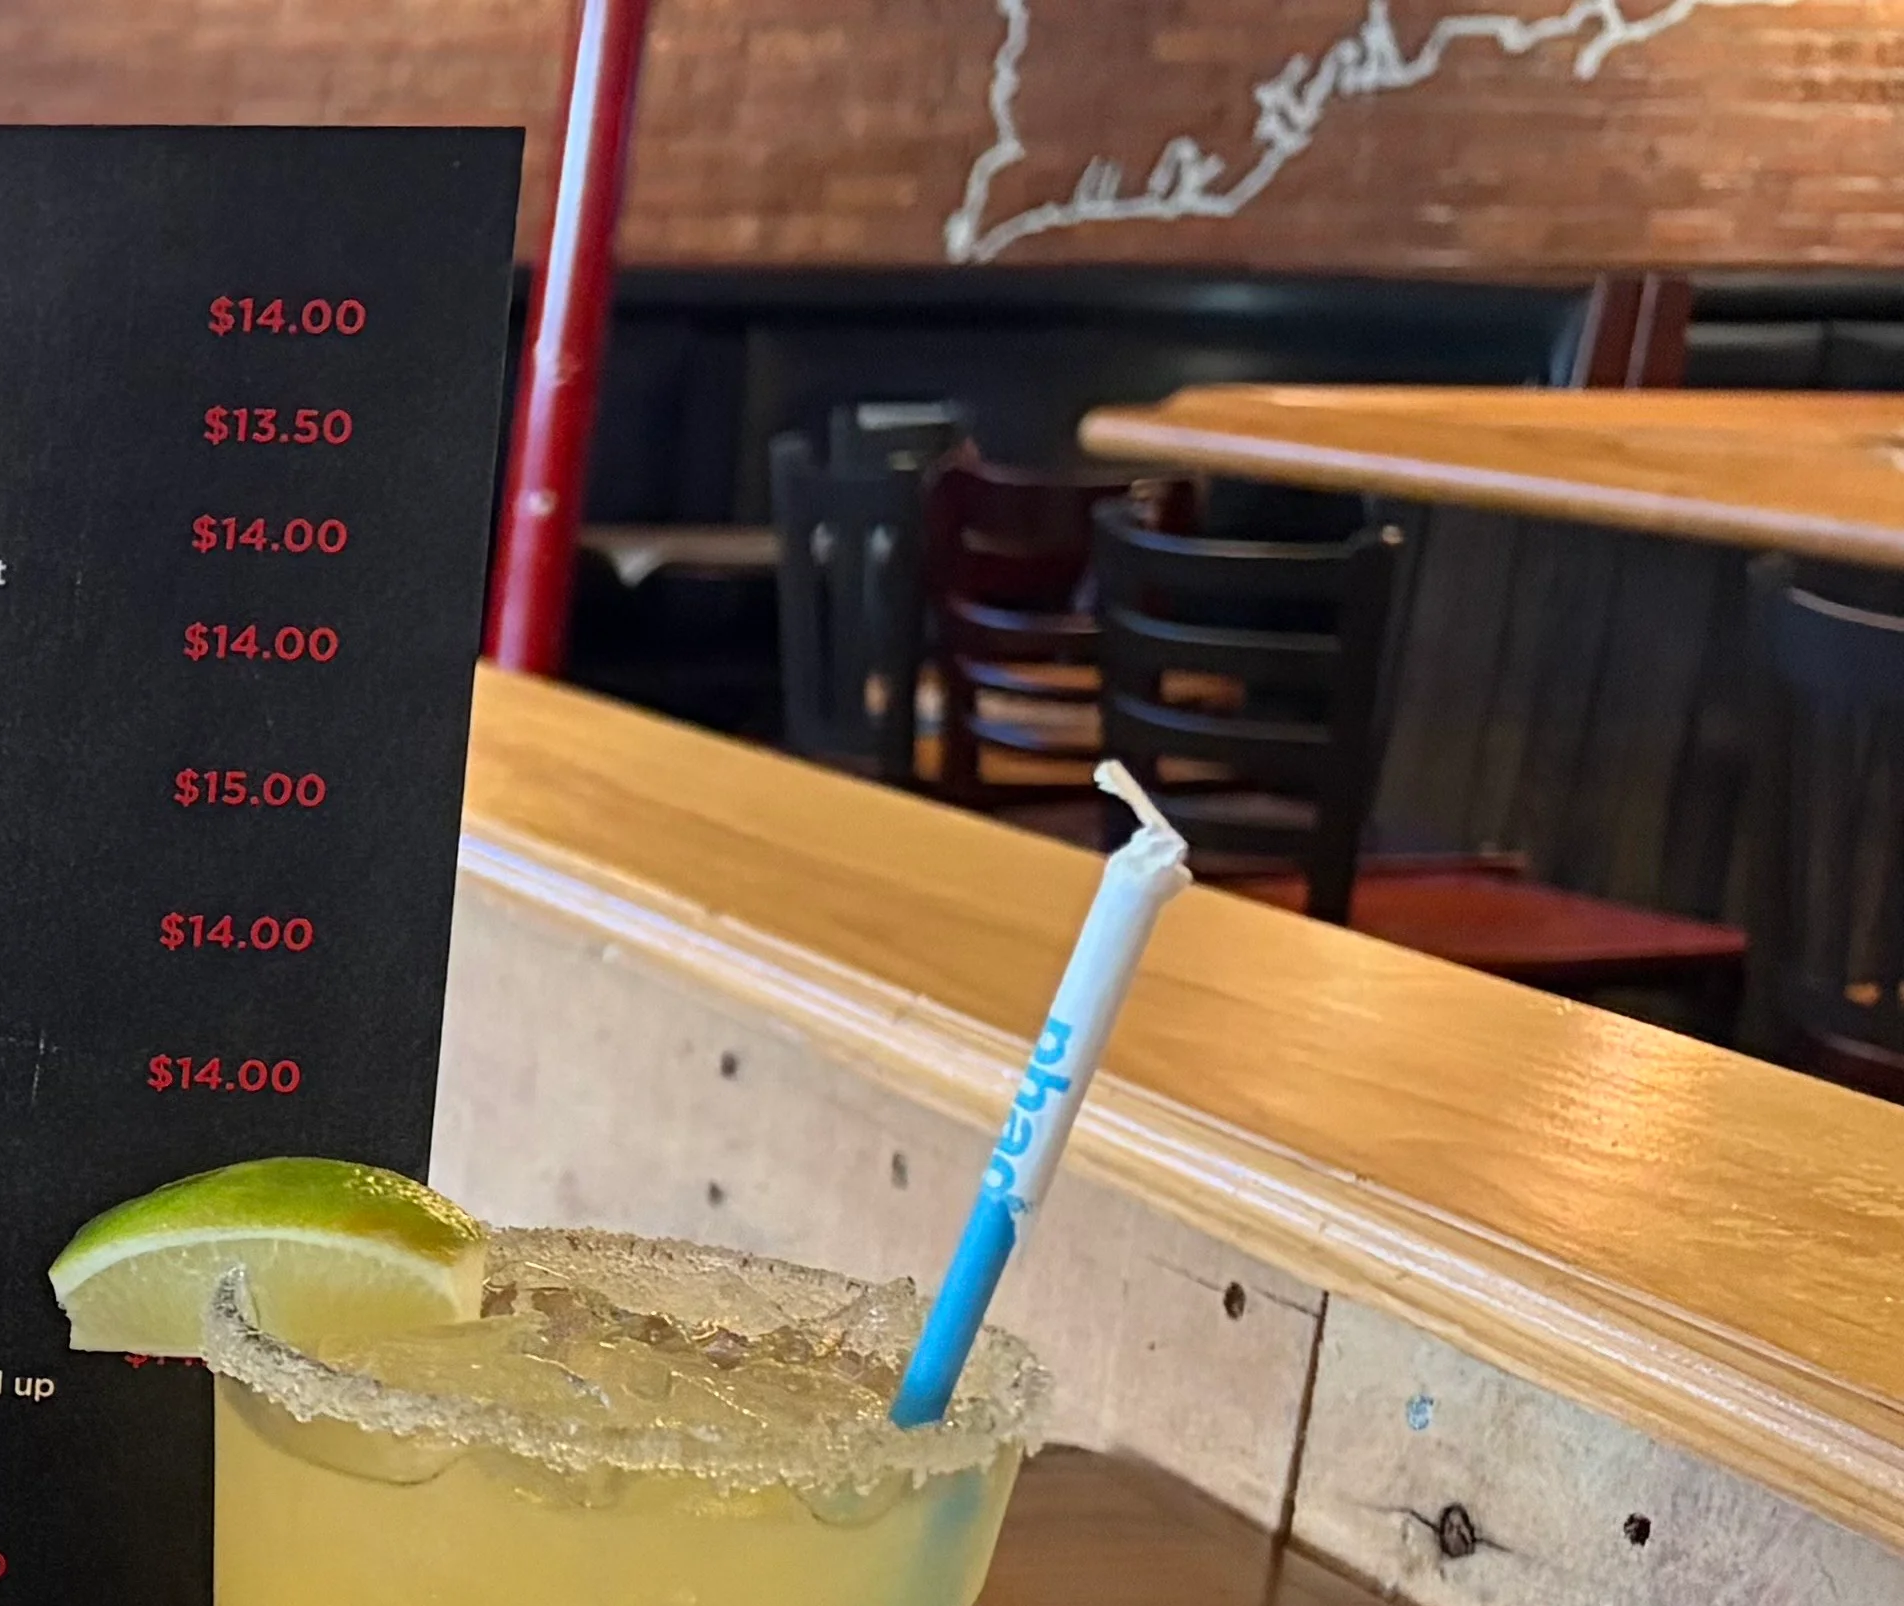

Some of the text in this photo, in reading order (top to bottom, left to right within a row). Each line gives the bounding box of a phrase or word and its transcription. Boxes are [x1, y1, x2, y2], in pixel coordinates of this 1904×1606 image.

[210, 296, 367, 336] $14.00
[205, 406, 353, 446] $13.50
[193, 515, 349, 554] $14.00
[184, 623, 339, 663] $14.00
[175, 768, 327, 808] $15.00
[160, 912, 314, 952] $14.00
[148, 1055, 302, 1094] $14.00
[14, 1377, 55, 1402] up
